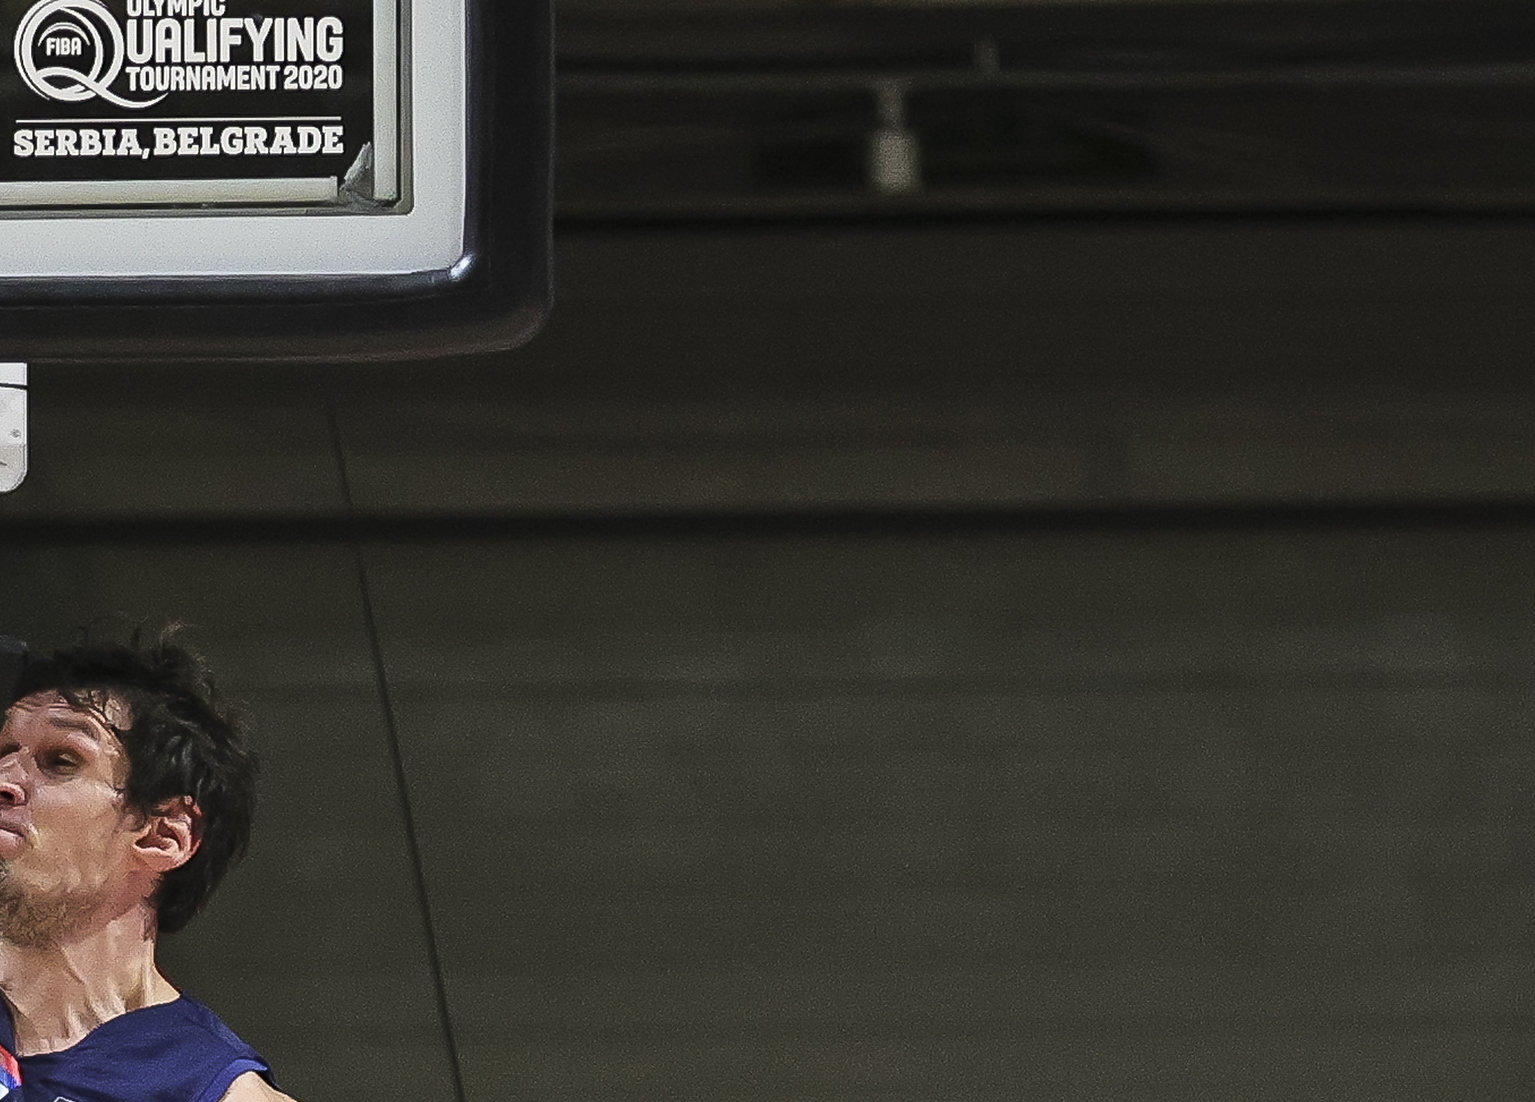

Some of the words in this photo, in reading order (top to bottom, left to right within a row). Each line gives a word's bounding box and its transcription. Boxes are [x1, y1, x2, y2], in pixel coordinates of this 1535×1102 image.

[45, 37, 82, 56] FIBA
[125, 65, 280, 92] TOURNAMENT
[284, 65, 344, 91] 2020
[13, 128, 151, 159] SERBIA,
[154, 126, 344, 155] BELGRADE
